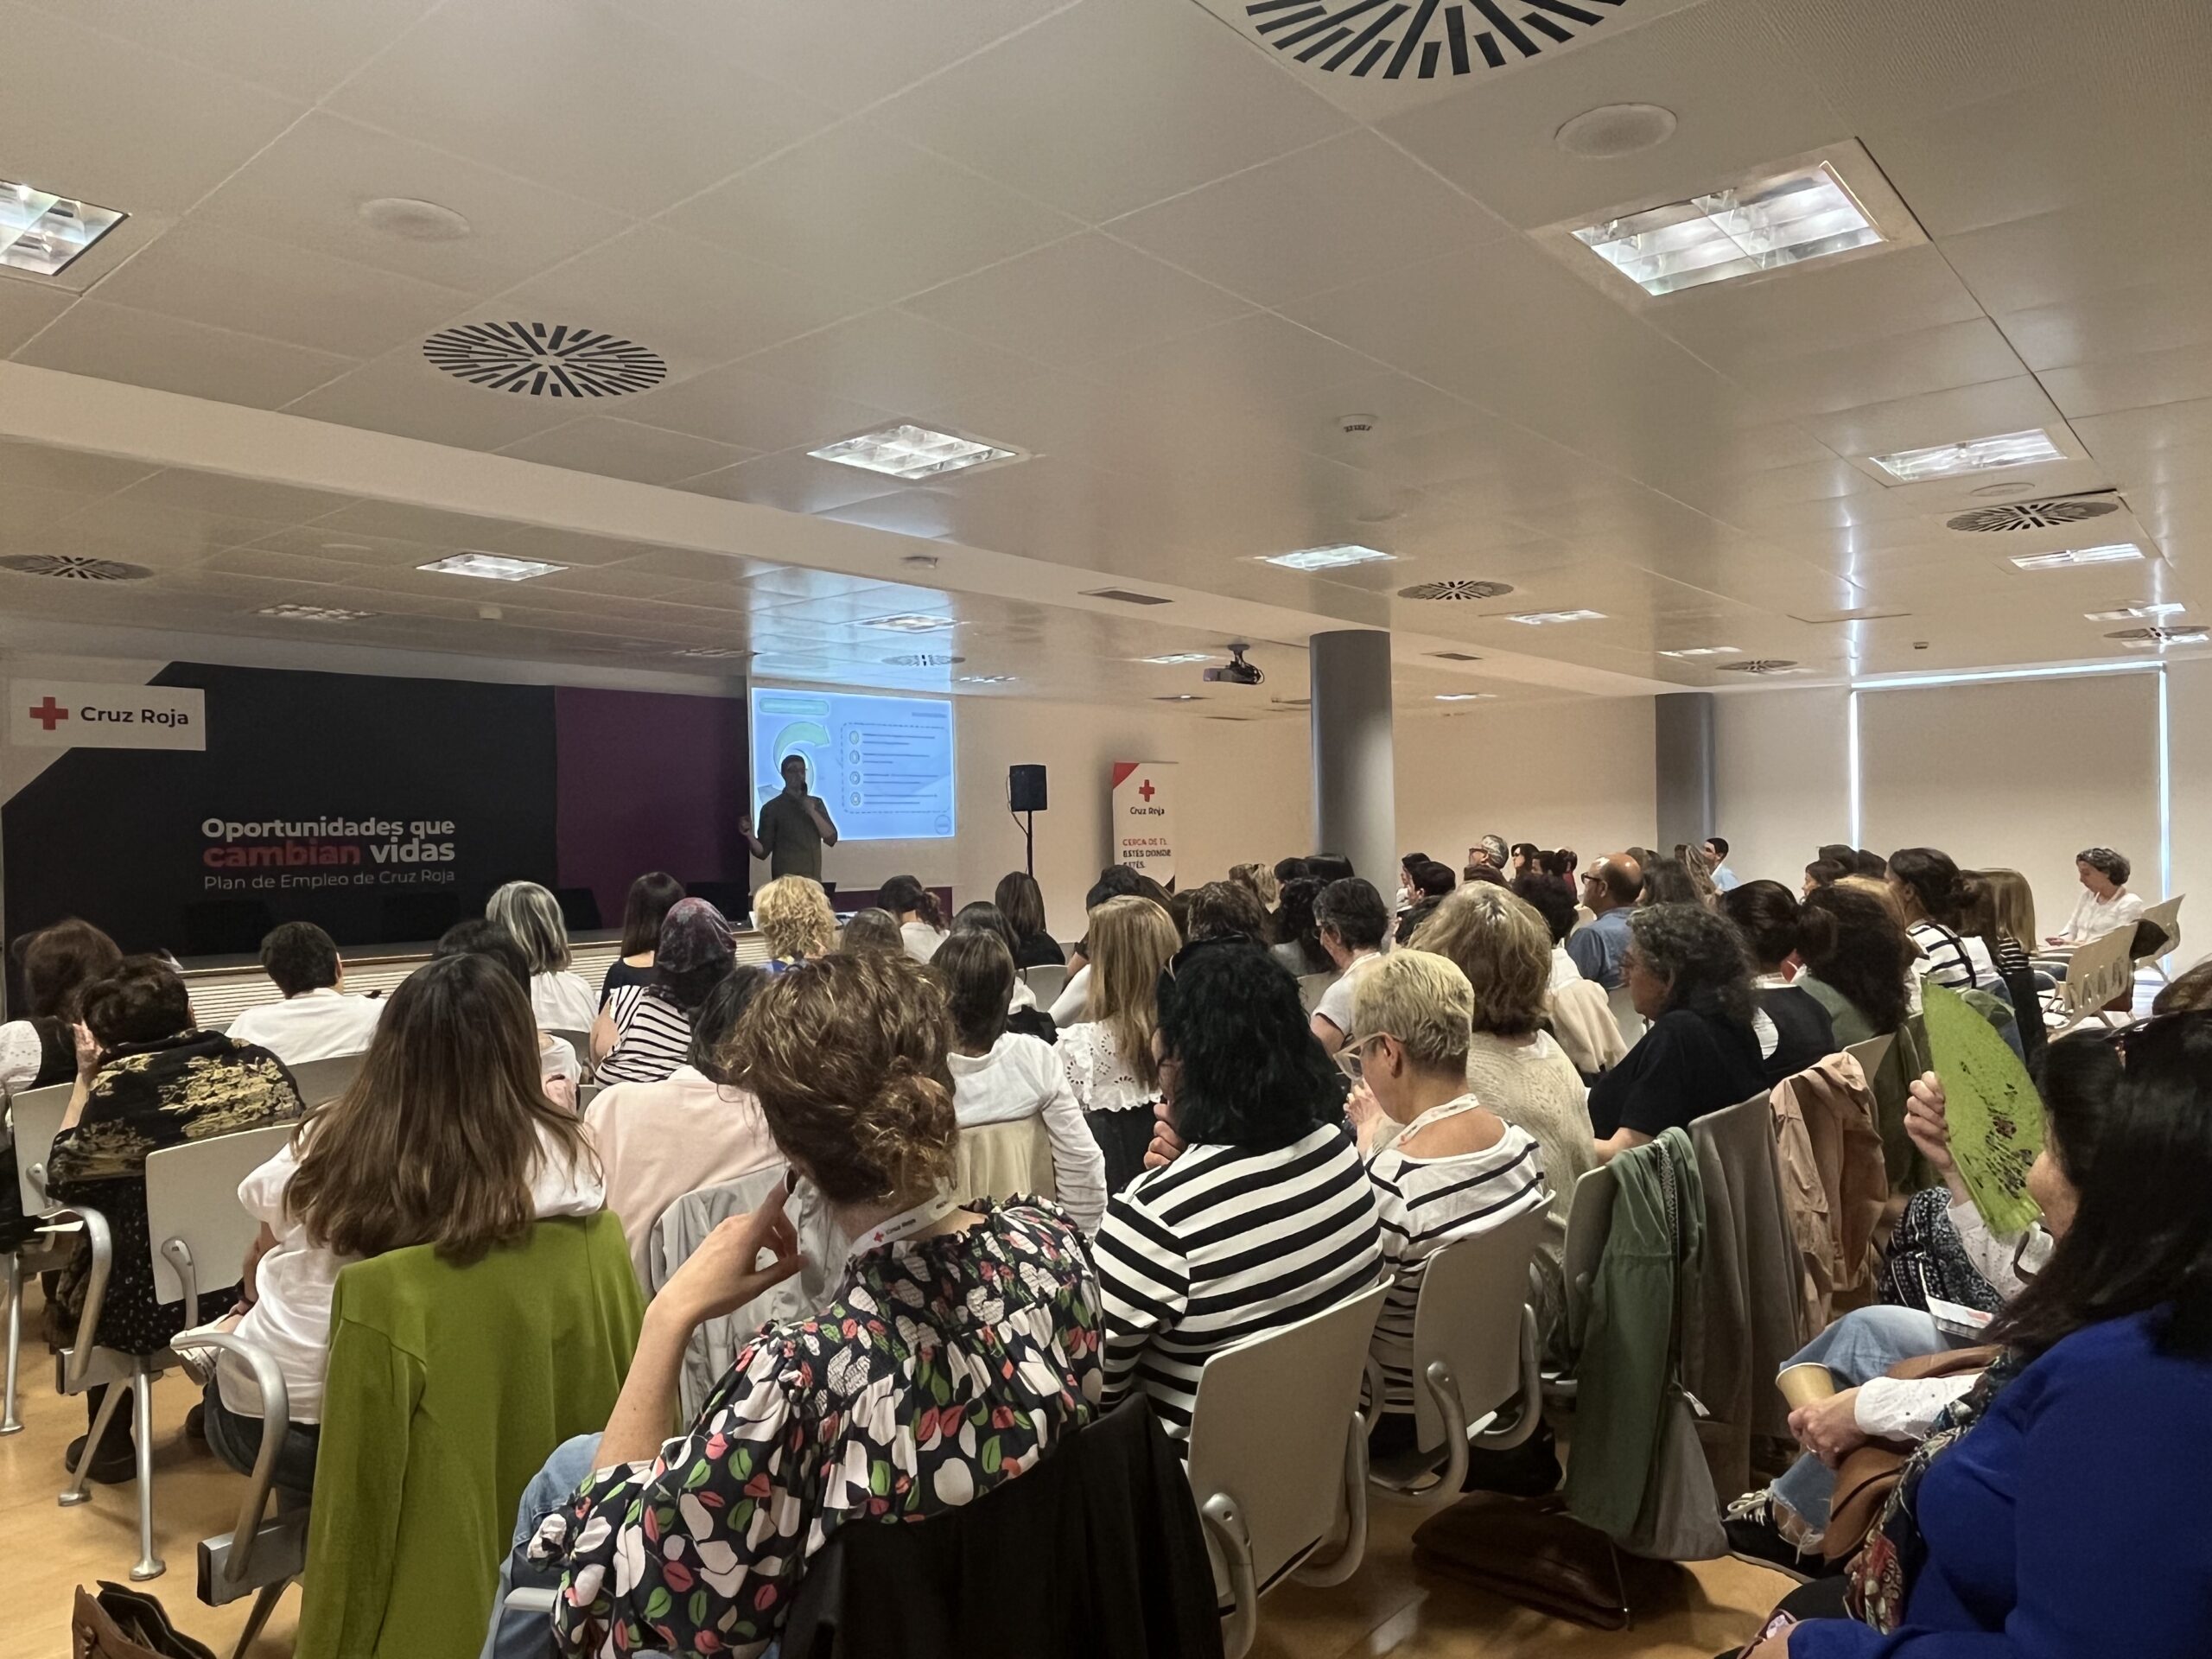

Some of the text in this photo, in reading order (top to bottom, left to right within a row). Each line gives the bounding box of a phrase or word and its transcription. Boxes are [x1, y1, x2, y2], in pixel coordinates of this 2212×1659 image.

[80, 706, 189, 728] Cruz Roja
[1129, 806, 1147, 815] Cruz
[201, 816, 455, 842] Oportunidades que
[203, 836, 455, 868] cambian vidas
[204, 868, 454, 890] Plan de Empleo de Cruz Roja
